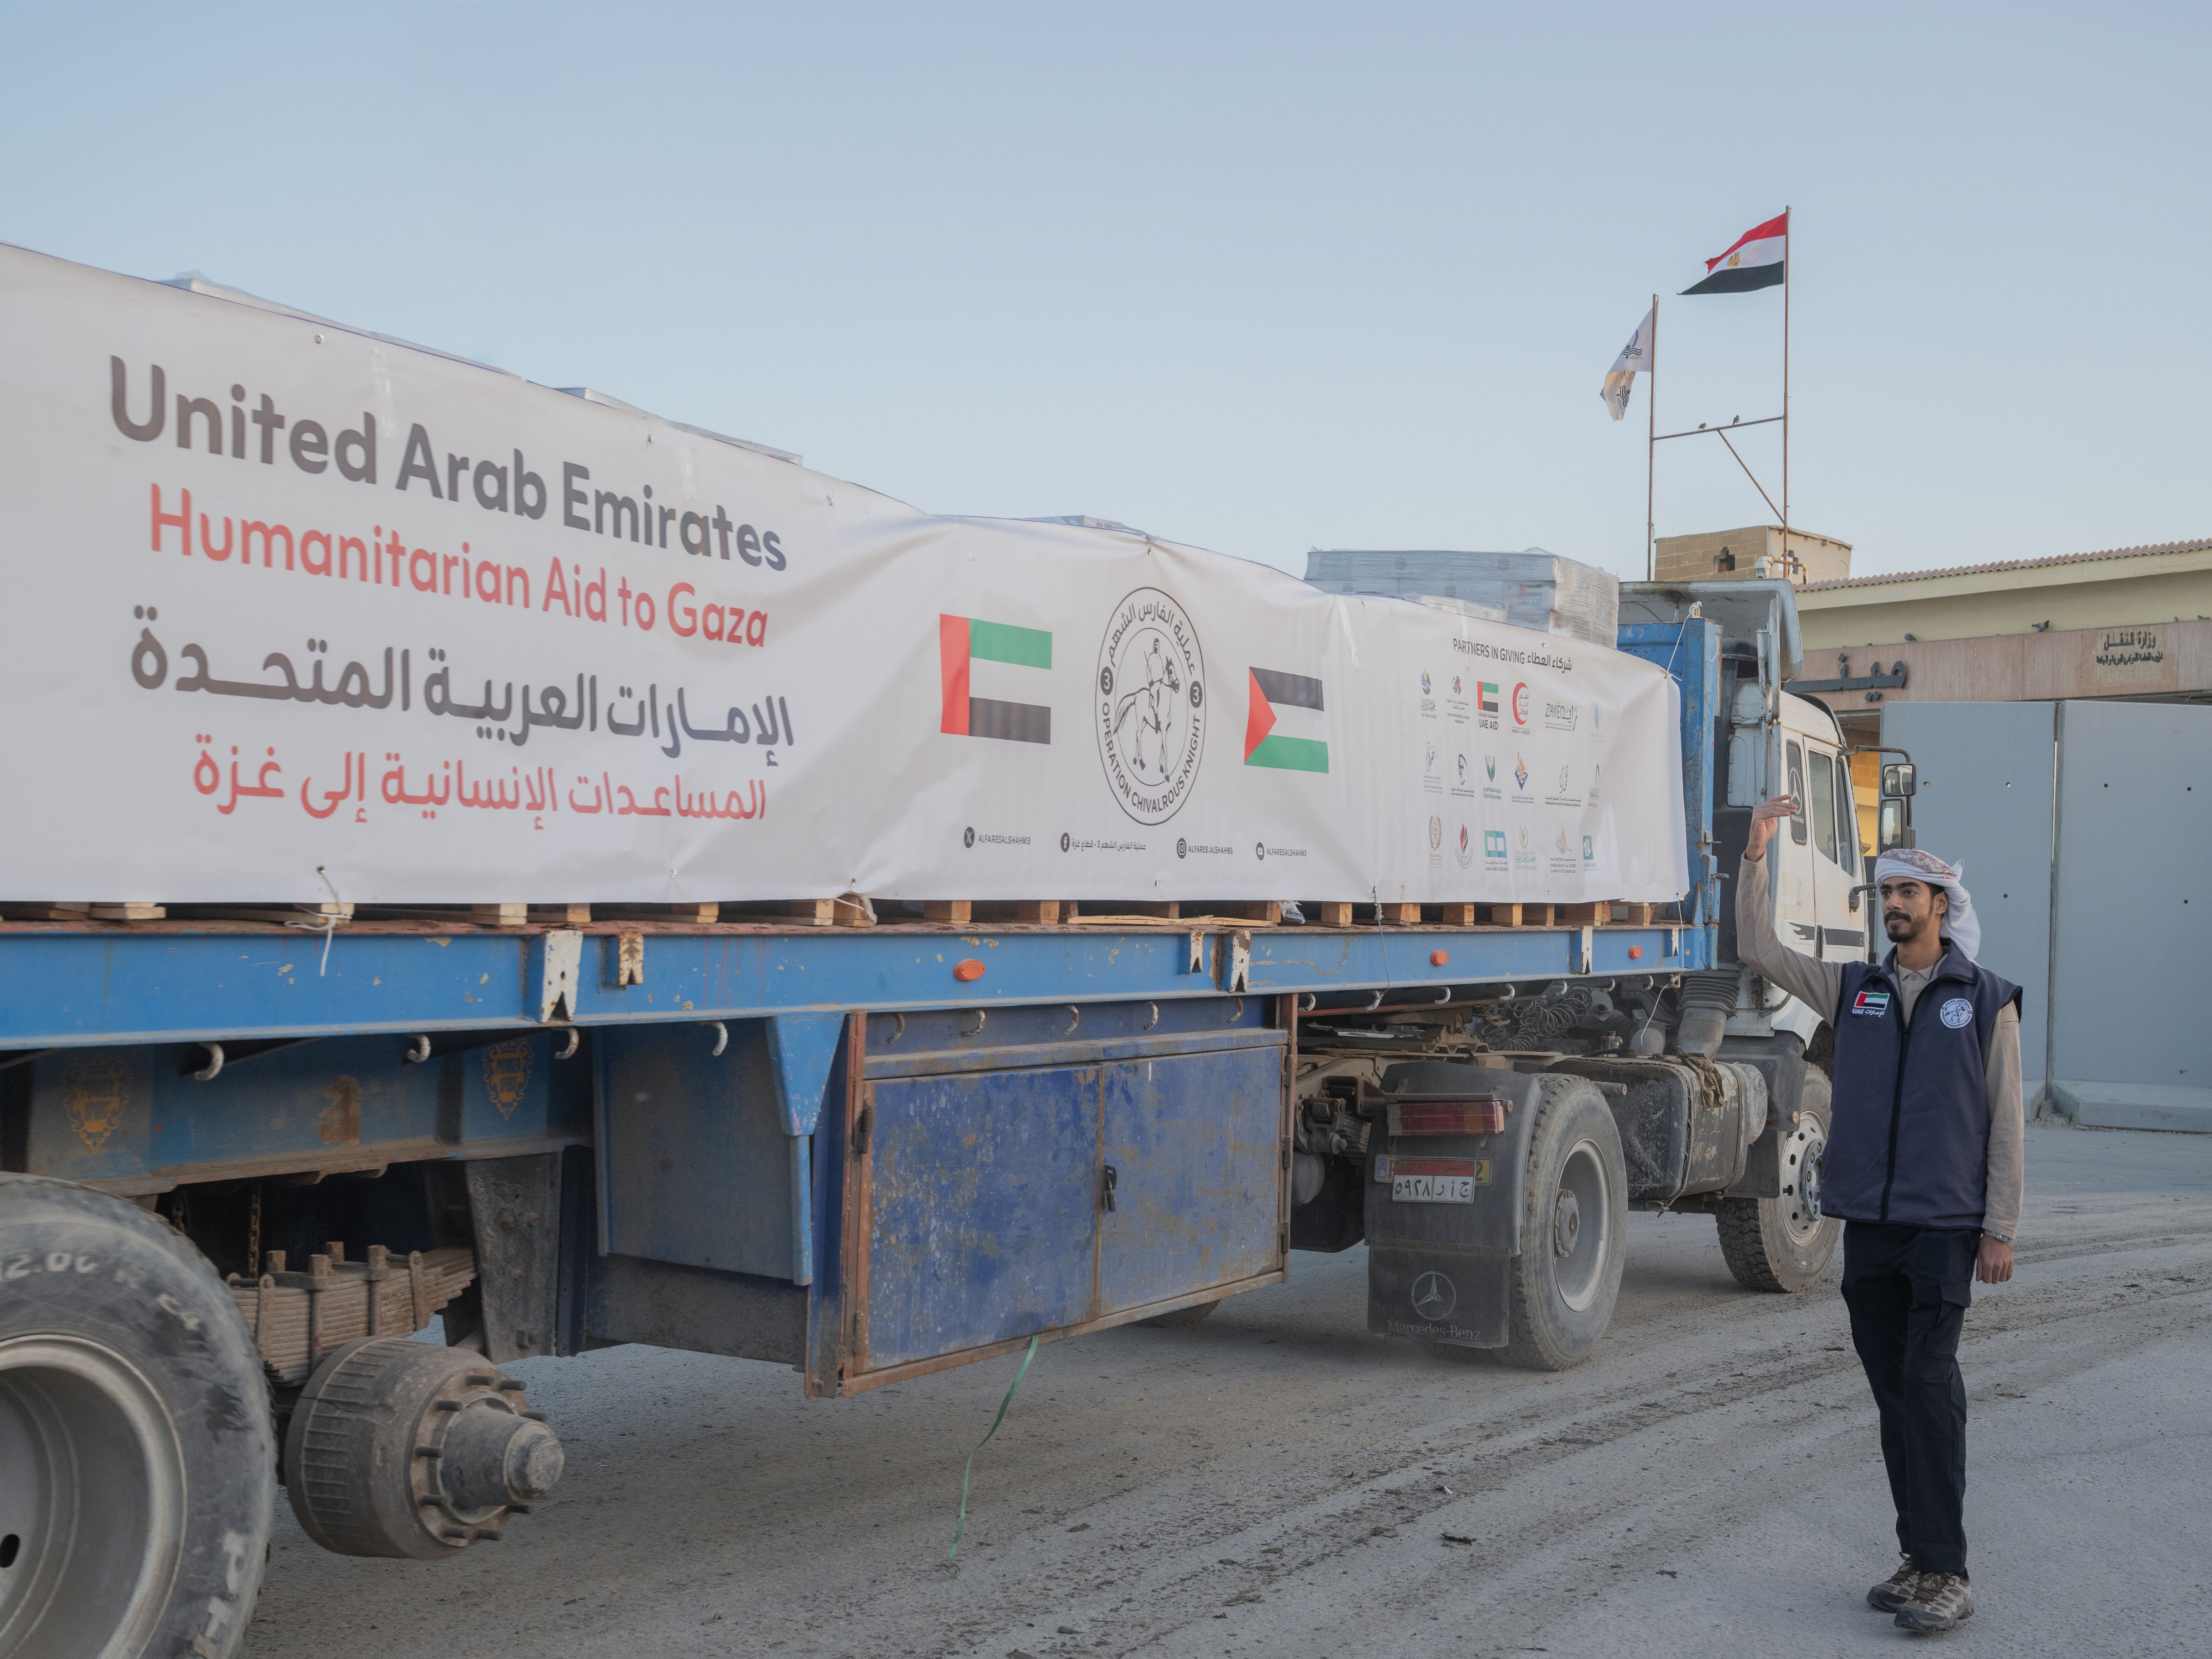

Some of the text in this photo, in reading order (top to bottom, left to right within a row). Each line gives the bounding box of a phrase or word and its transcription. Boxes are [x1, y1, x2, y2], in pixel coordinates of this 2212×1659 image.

[111, 355, 787, 571] United Arab Emirates
[151, 483, 768, 647] Humanitarian Aid to Gaza
[1109, 601, 1194, 676] عملية الفارس الشهم
[2104, 631, 2156, 651] وزارة النقل
[1453, 638, 1525, 664] PARTNERS IN GIVING
[1527, 652, 1572, 673] شركاء العطاء
[131, 605, 794, 767] الإمارات العربية المتحدة
[1479, 719, 1498, 730] UAE AID
[1103, 702, 1200, 813] OPERATION CHIVALROUS KNIGHT
[194, 733, 766, 830] المساعدات الإنسانية إلى غزة
[978, 835, 1030, 845] ALFARESALSHAHM3
[1188, 845, 1233, 854] ALFARES.ALSHAHM3
[1267, 848, 1307, 857] ALFARESALSHAHM3
[1387, 1320, 1481, 1341] Mercedes-Benz
